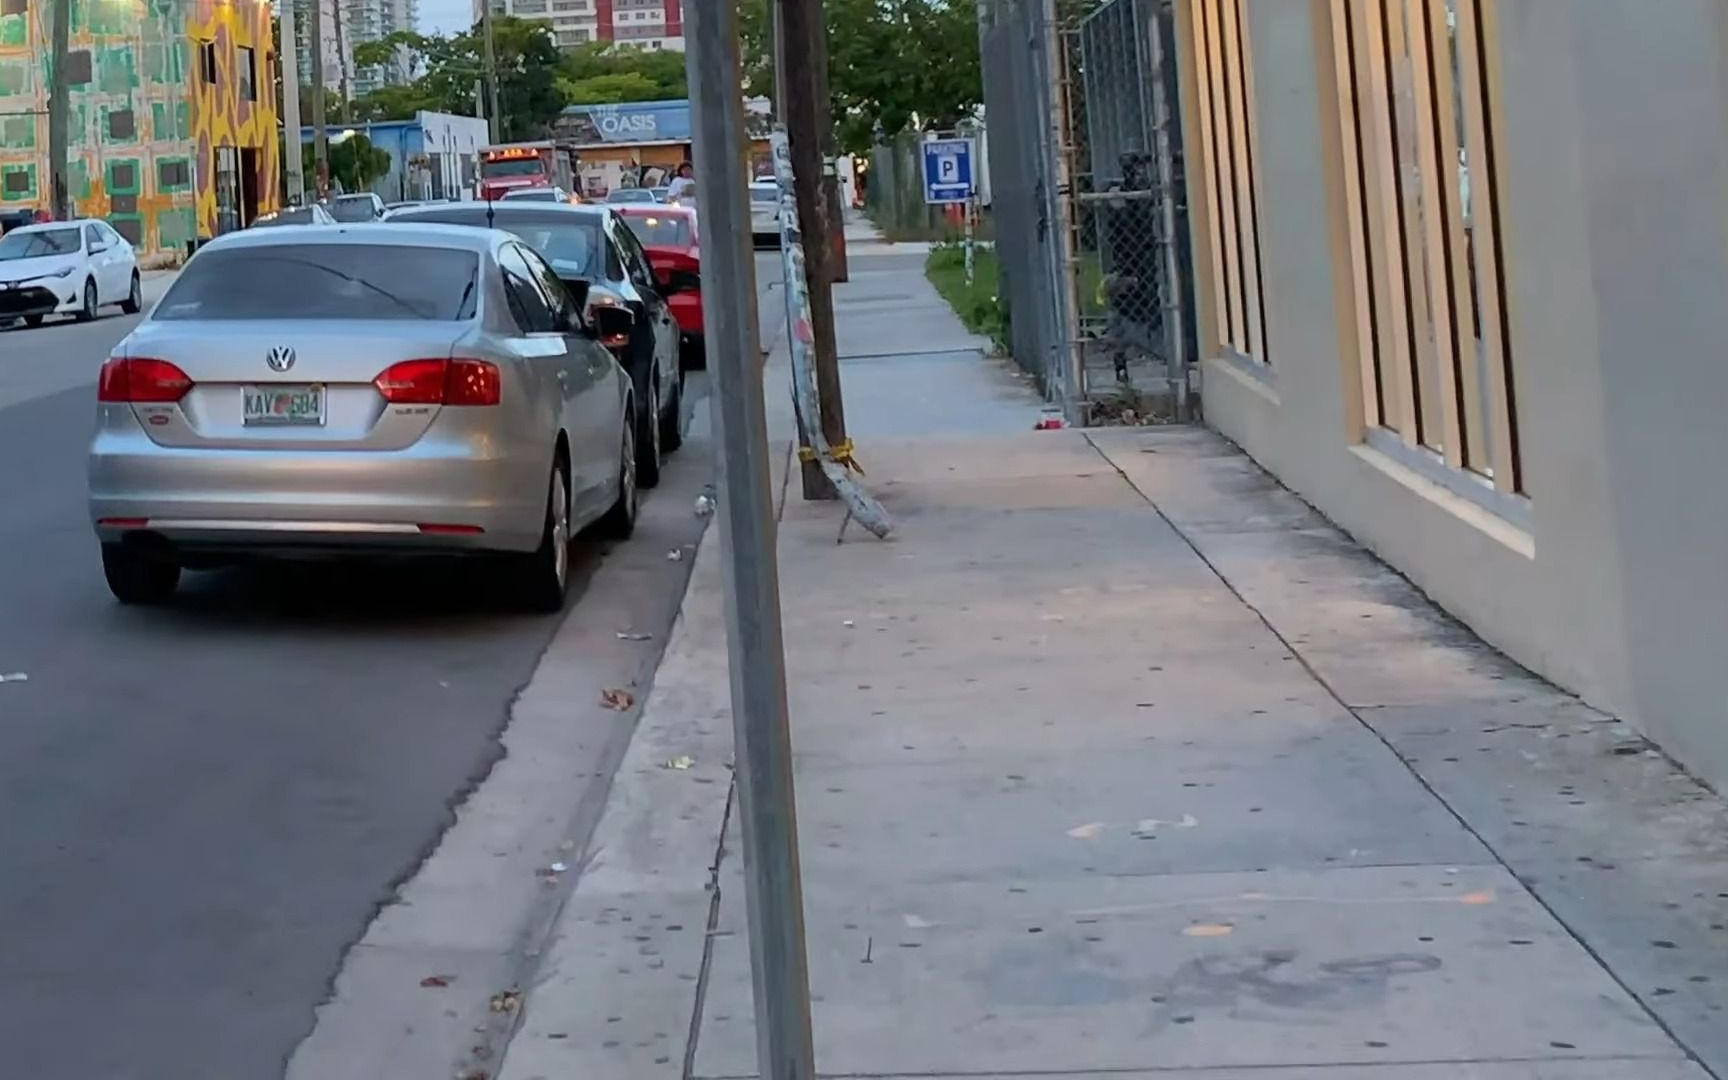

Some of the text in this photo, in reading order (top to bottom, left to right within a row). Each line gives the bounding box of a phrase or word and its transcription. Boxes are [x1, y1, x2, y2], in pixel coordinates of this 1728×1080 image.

[602, 113, 657, 133] OASIS
[943, 160, 954, 177] P
[244, 394, 273, 417] KAV
